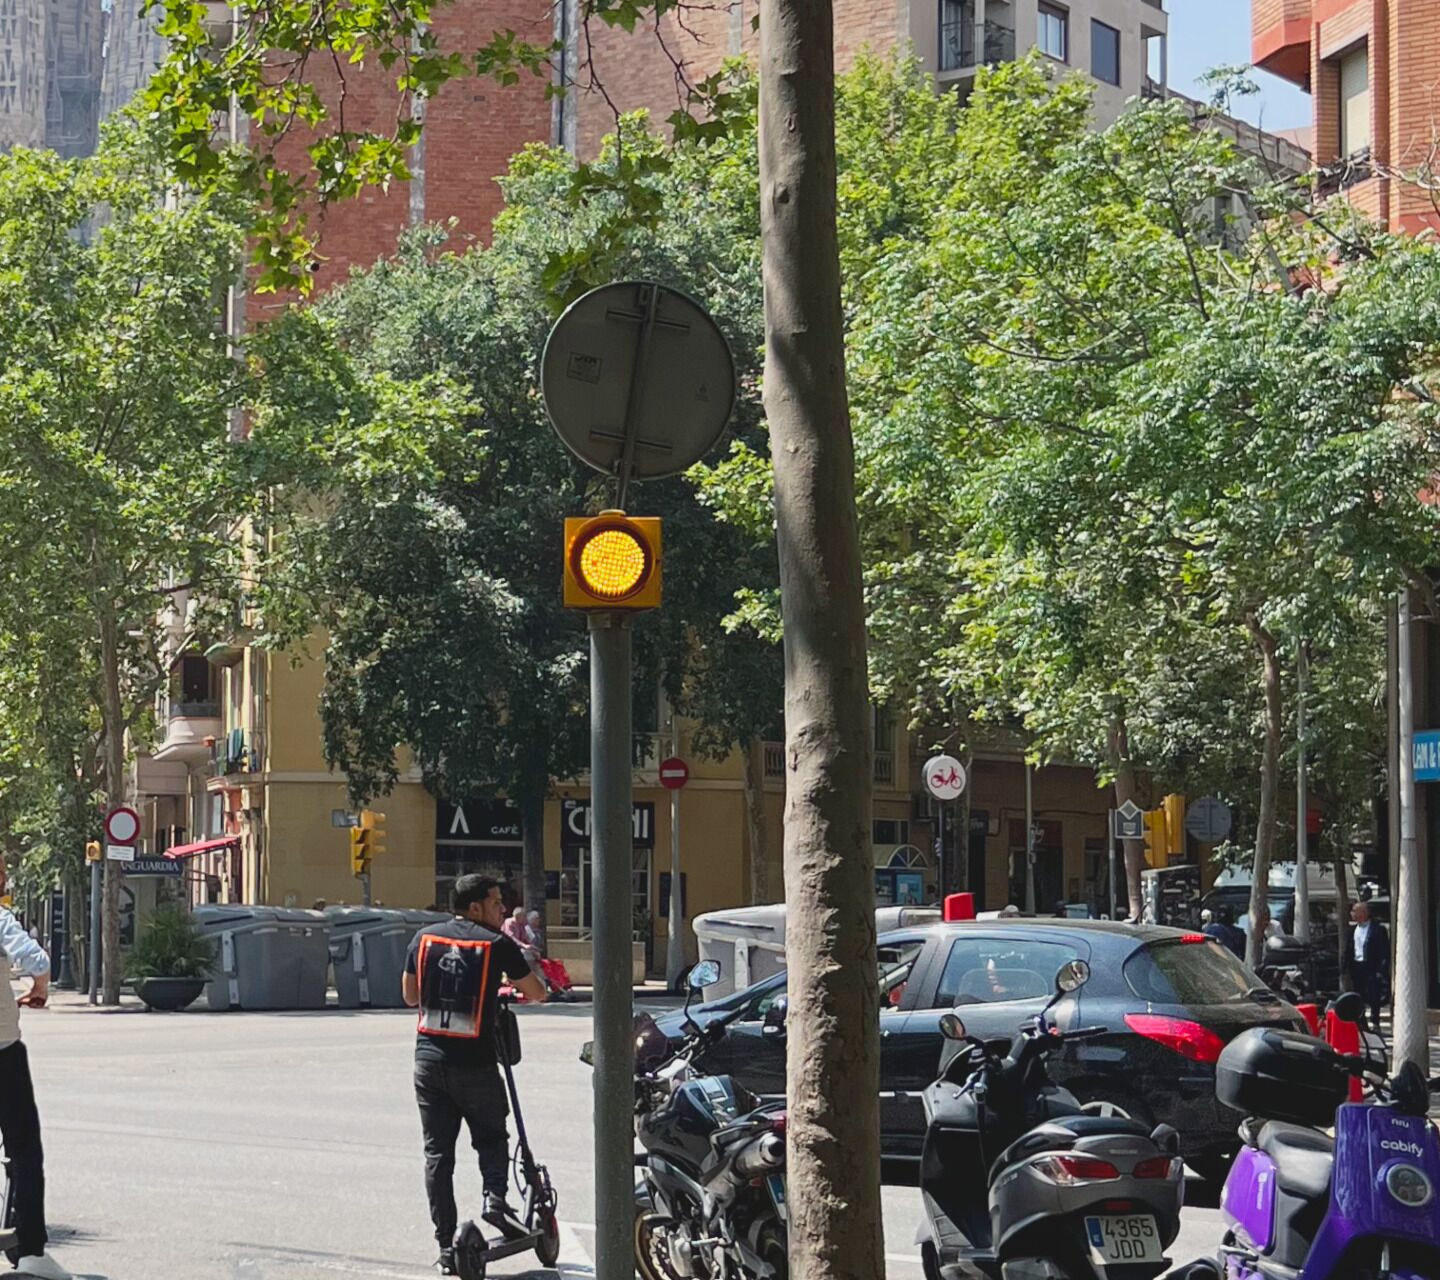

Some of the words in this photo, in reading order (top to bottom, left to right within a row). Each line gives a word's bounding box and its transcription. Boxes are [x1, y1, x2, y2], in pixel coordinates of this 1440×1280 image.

[1380, 1139, 1424, 1158] cabify
[1104, 1217, 1154, 1238] 4365
[1109, 1239, 1146, 1260] JDD
